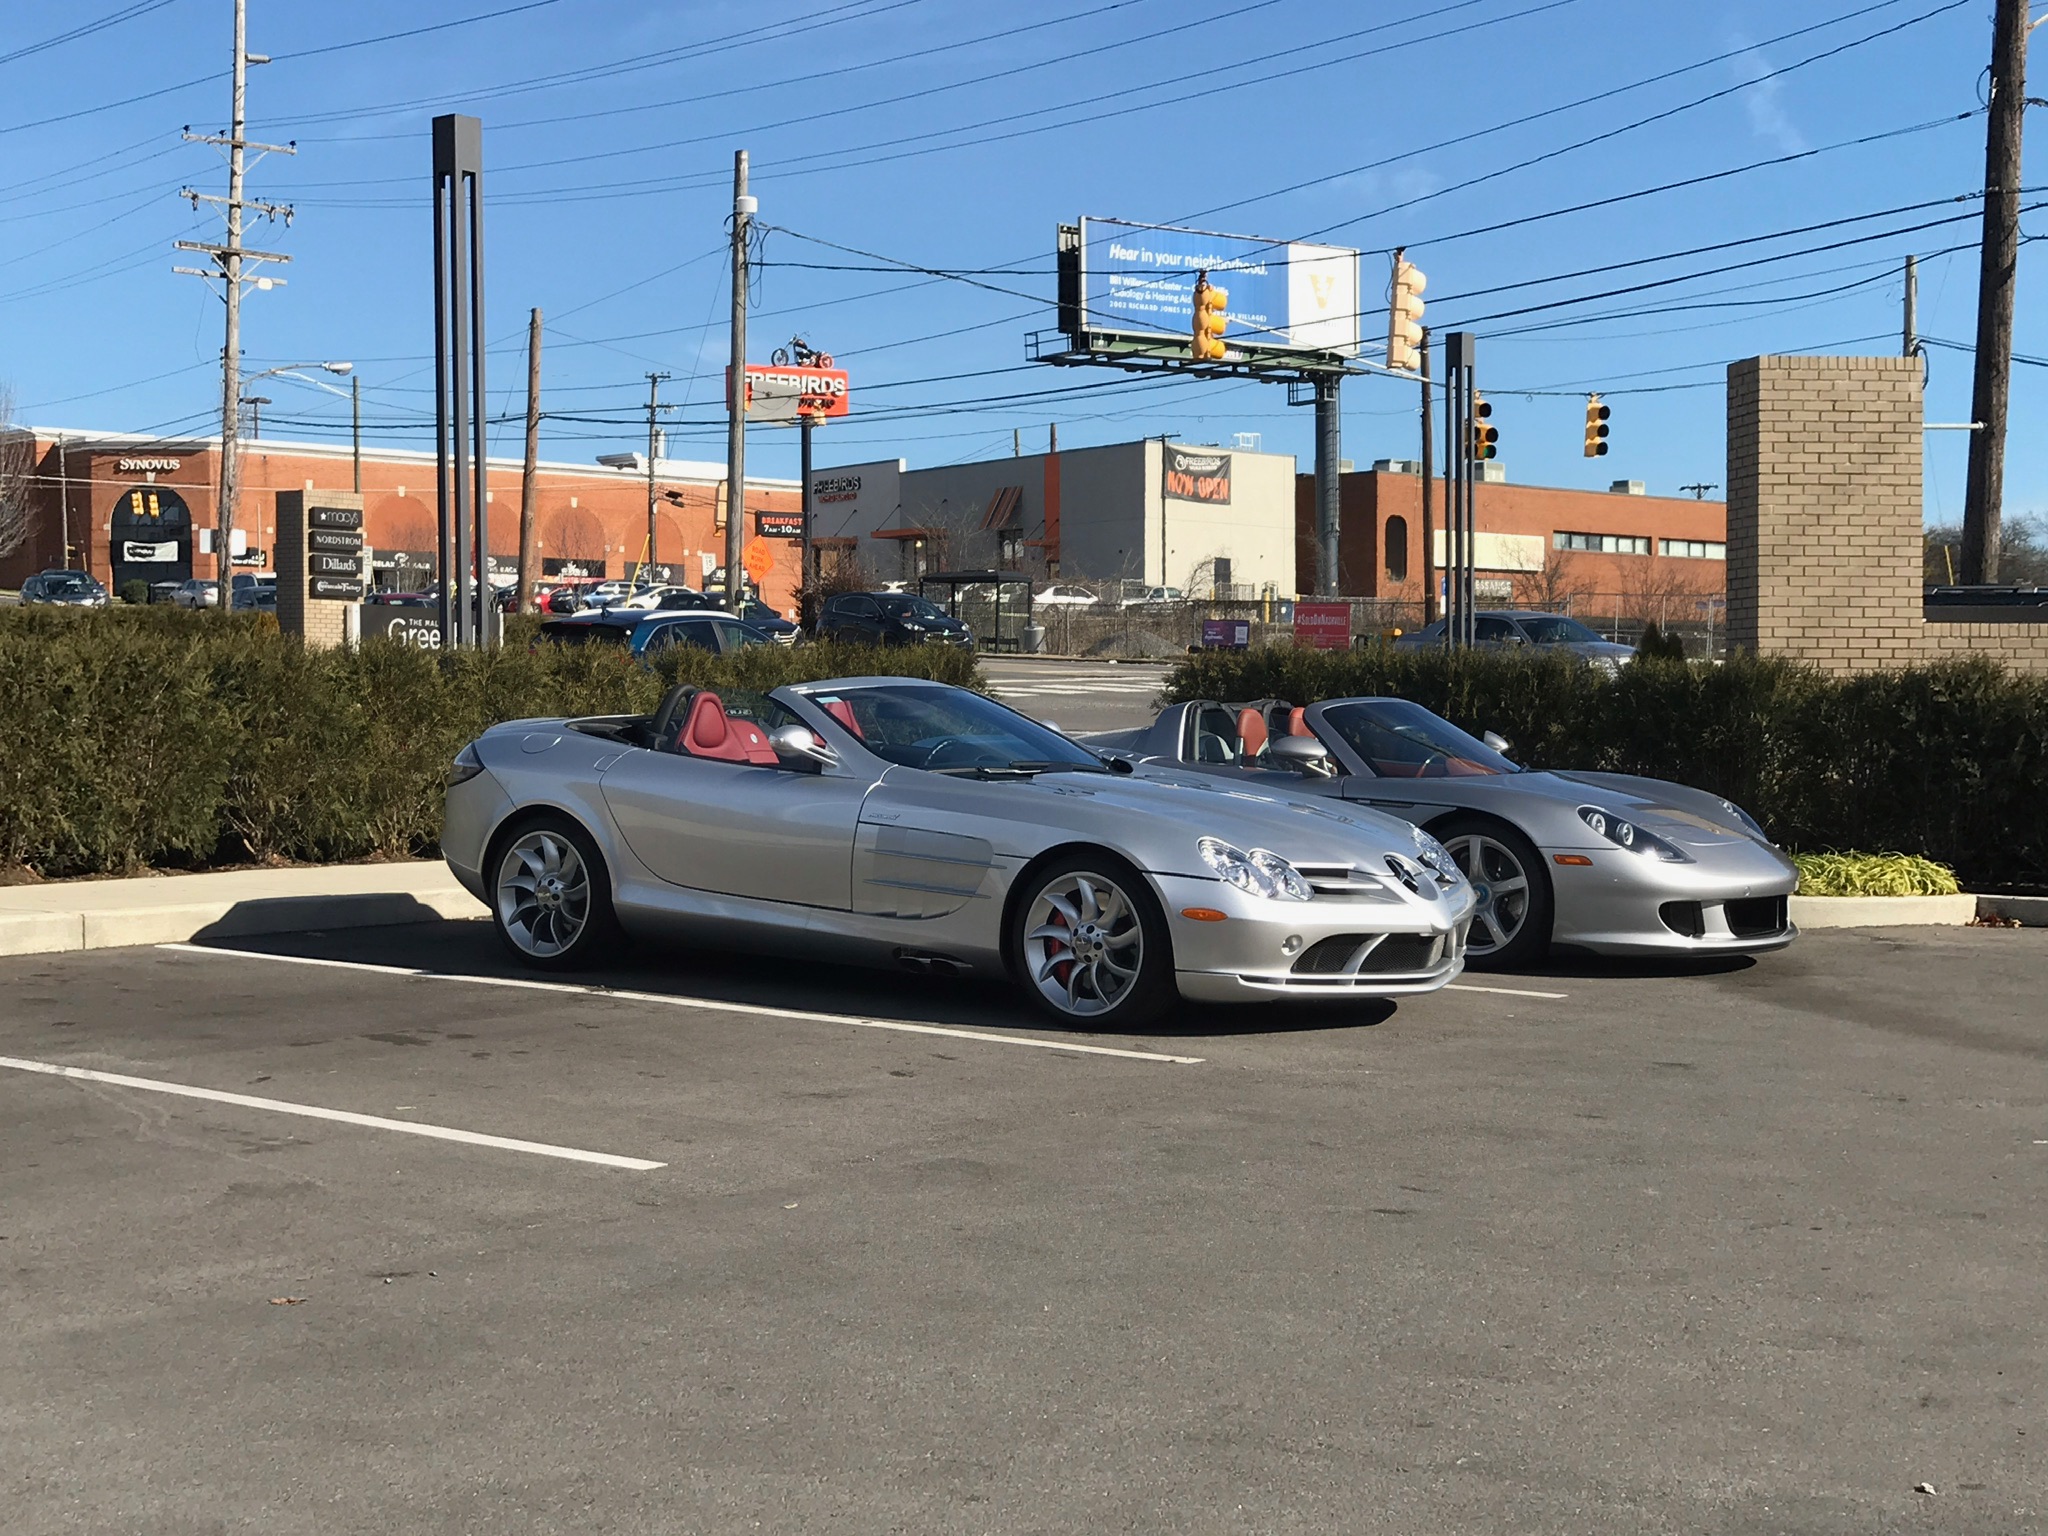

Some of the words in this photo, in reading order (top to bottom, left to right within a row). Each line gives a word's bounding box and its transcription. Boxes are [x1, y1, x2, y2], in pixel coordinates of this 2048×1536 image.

[1109, 243, 1139, 262] Hear
[1141, 247, 1153, 262] in
[1155, 252, 1182, 267] your
[1159, 280, 1182, 292] Center
[1145, 291, 1151, 300] &
[1152, 291, 1179, 305] Hearing
[1179, 294, 1192, 304] Aid
[1128, 303, 1159, 312] RICHARD
[1160, 305, 1181, 314] JONES
[119, 459, 181, 470] SYNOVUS
[1168, 470, 1194, 496] NOW
[1198, 477, 1228, 499] OPEN
[761, 516, 803, 526] BREAKFAST
[316, 535, 362, 546] NORDSTROM
[322, 557, 356, 571] Dillard's
[372, 559, 396, 569] RELAX
[409, 619, 423, 627] THE
[425, 619, 440, 628] MAL
[388, 617, 441, 651] Gree
